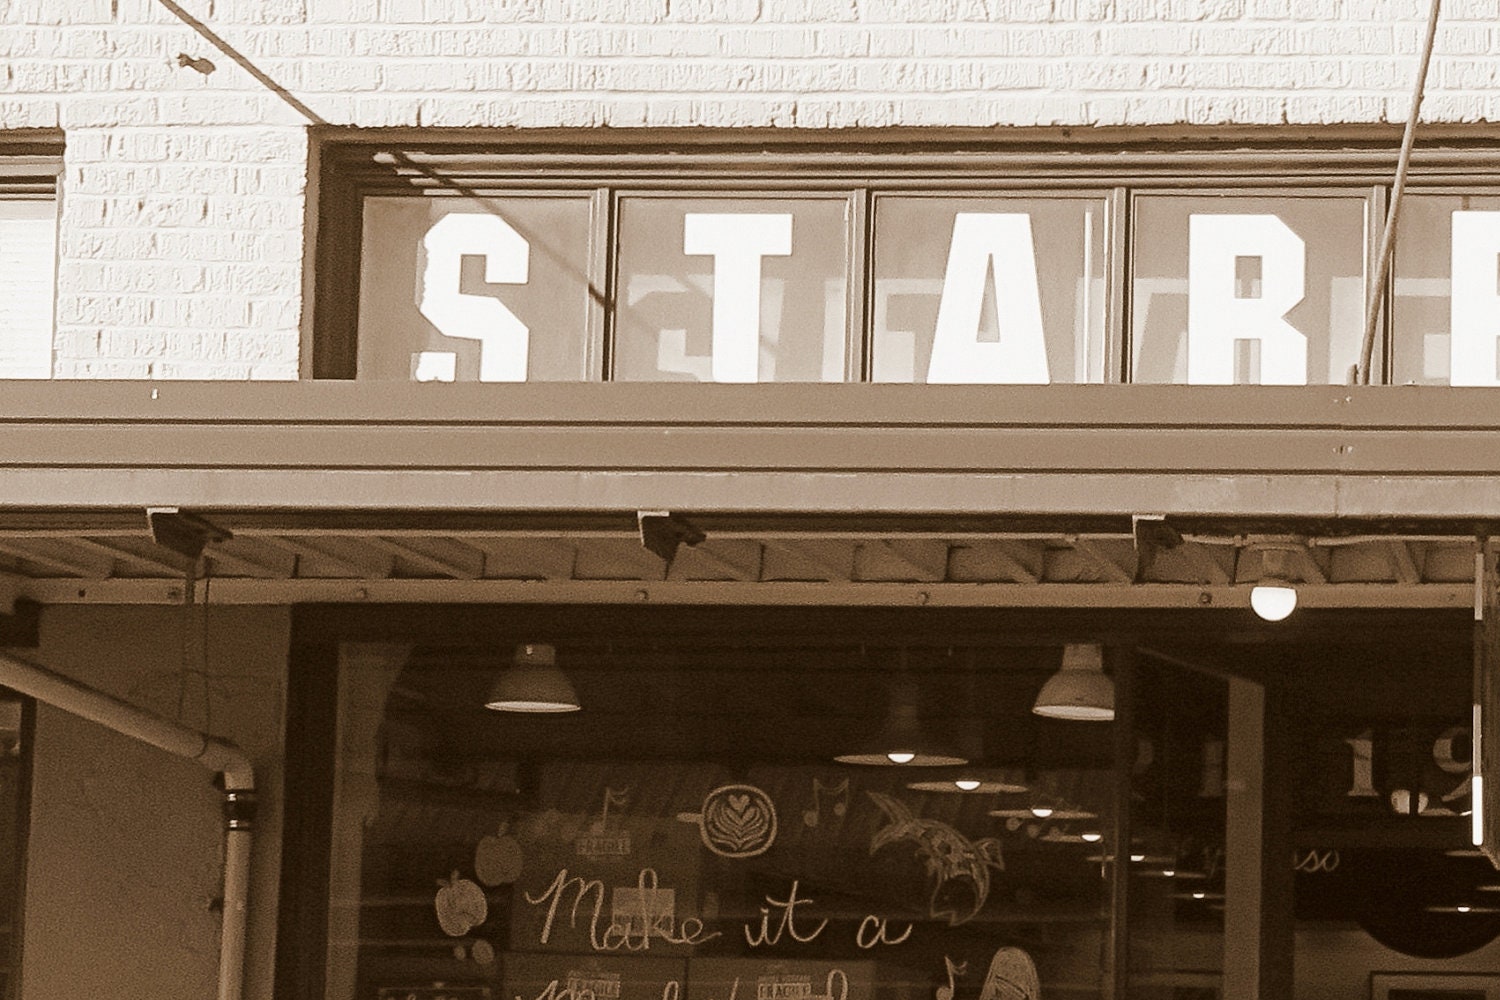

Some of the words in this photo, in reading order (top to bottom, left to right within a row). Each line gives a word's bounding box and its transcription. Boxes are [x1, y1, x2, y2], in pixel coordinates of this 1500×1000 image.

[524, 867, 722, 952] Make
[744, 880, 829, 948] it
[856, 914, 914, 950] a
